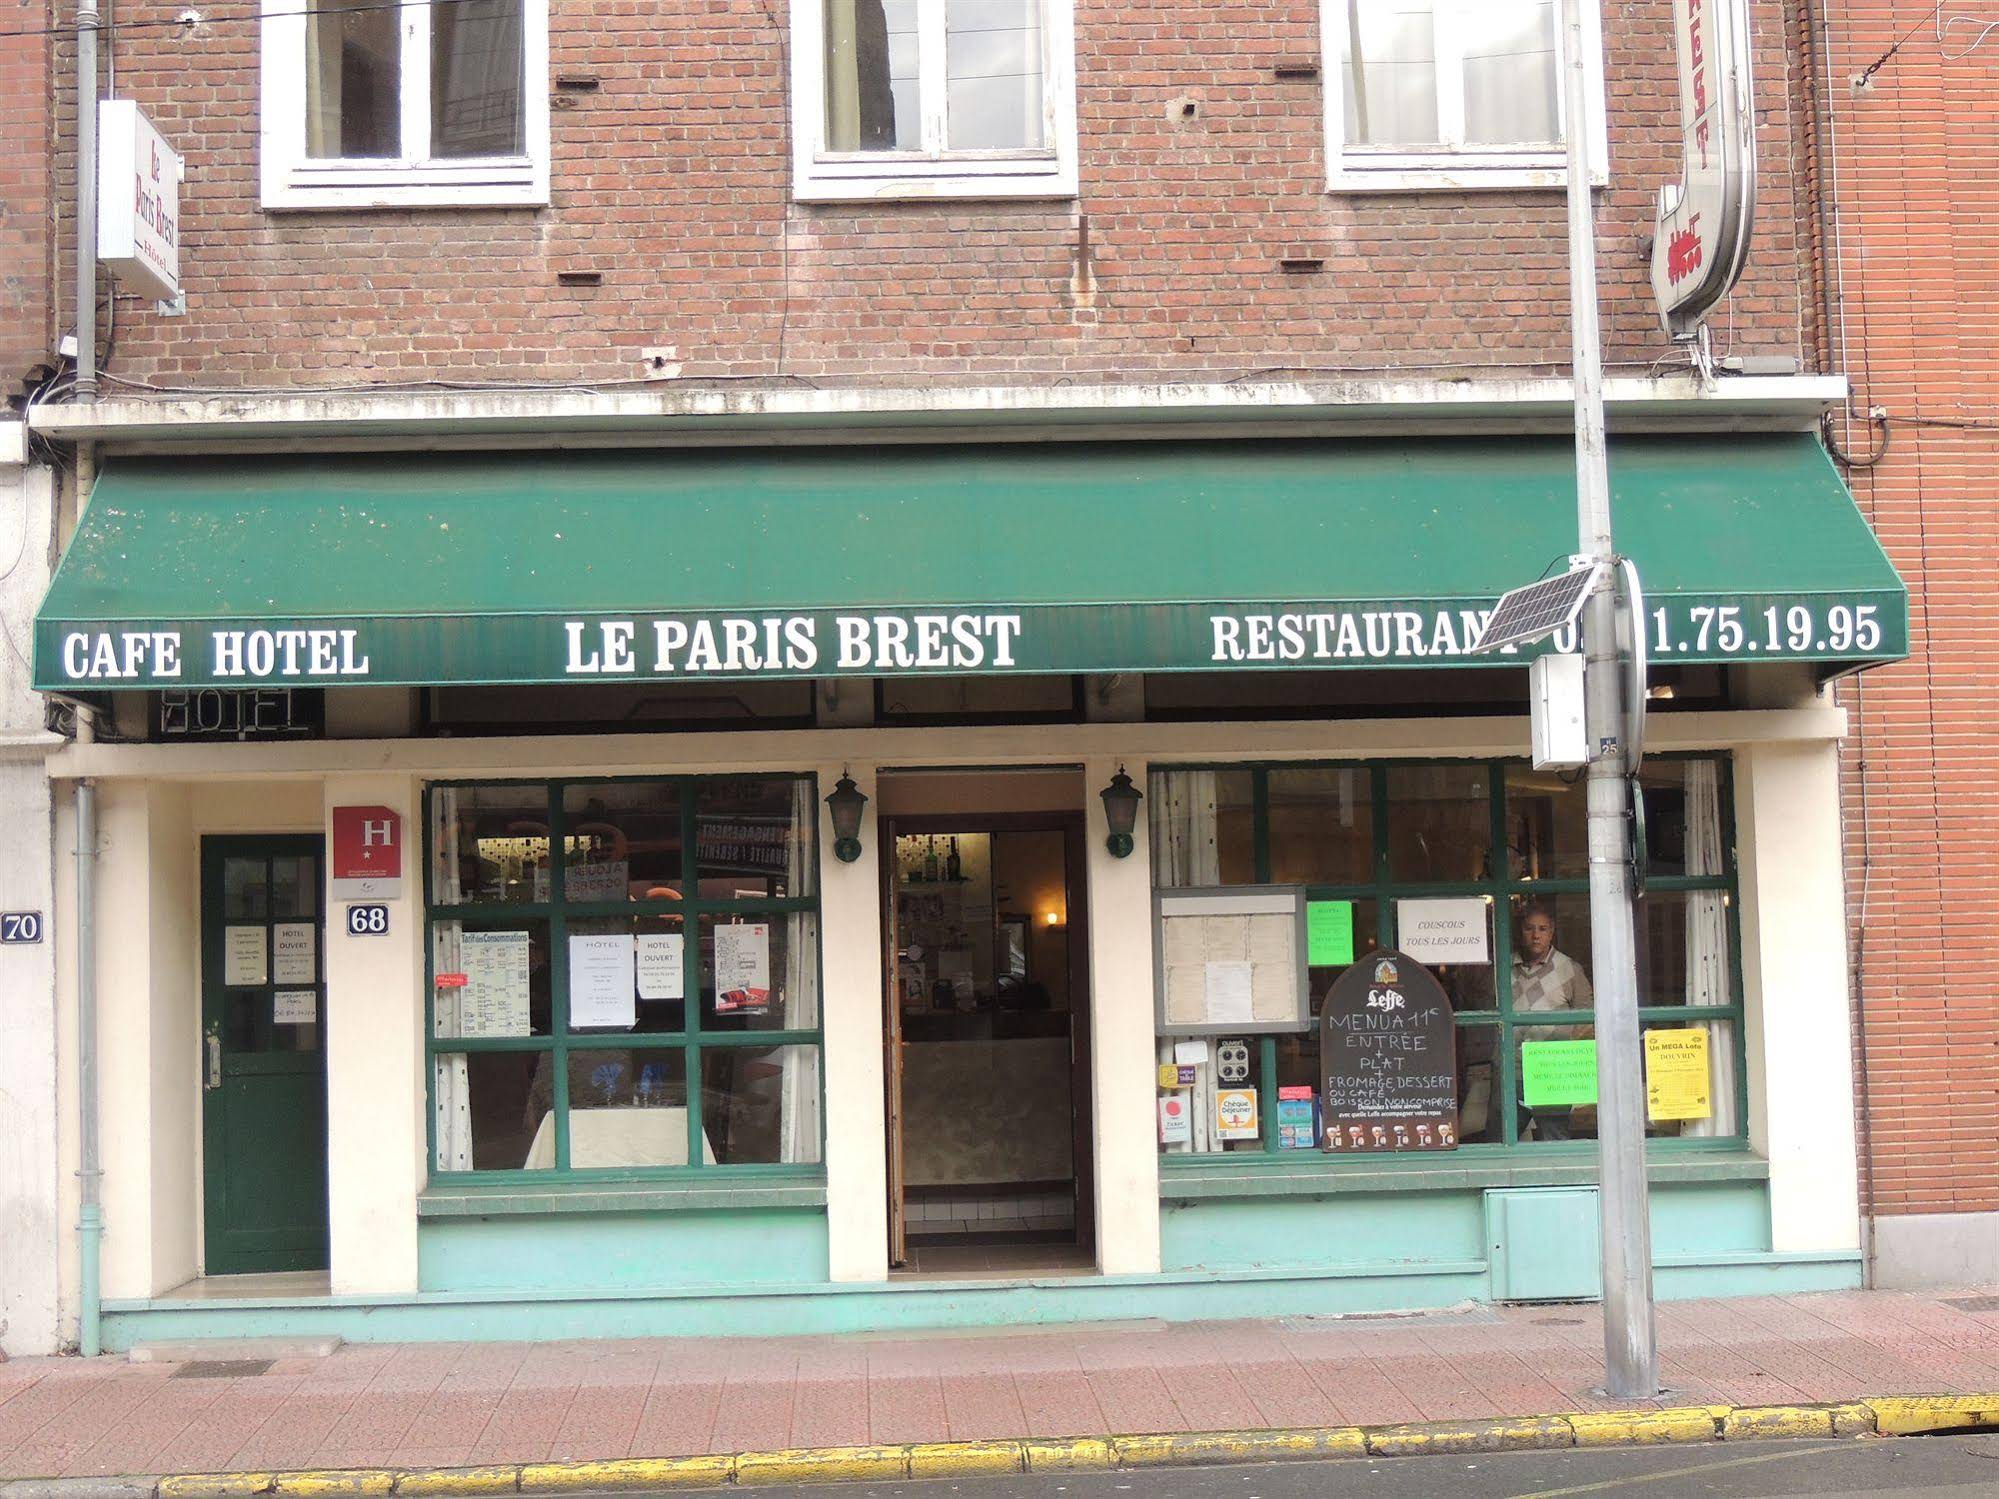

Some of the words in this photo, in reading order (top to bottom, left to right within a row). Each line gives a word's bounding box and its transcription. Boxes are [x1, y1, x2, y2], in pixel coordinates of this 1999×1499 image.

[135, 172, 155, 229] Paris
[155, 194, 175, 249] Brest
[143, 239, 168, 271] Hôtel
[564, 620, 636, 673] LE
[653, 616, 818, 672] PARIS
[836, 614, 1021, 668] BREST
[1209, 609, 1518, 661] RESTAURAN
[63, 631, 182, 679] CAFE
[212, 629, 370, 677] HOTEL
[1601, 743, 1617, 755] 25
[362, 819, 394, 846] H
[5, 914, 39, 941] 70
[351, 907, 386, 932] 68
[1417, 920, 1466, 930] COUSCOUS
[1406, 937, 1429, 946] TOUS
[1431, 937, 1449, 945] LES
[1450, 936, 1480, 945] JOURS
[644, 954, 673, 962] OUVERT
[1366, 989, 1405, 1012] Leffe
[1360, 1057, 1405, 1071] PLAT
[1396, 1076, 1453, 1089] DESSERT
[1329, 1089, 1346, 1098] OU
[1330, 1098, 1380, 1107] BOISSON
[1367, 1110, 1380, 1118] Leffe
